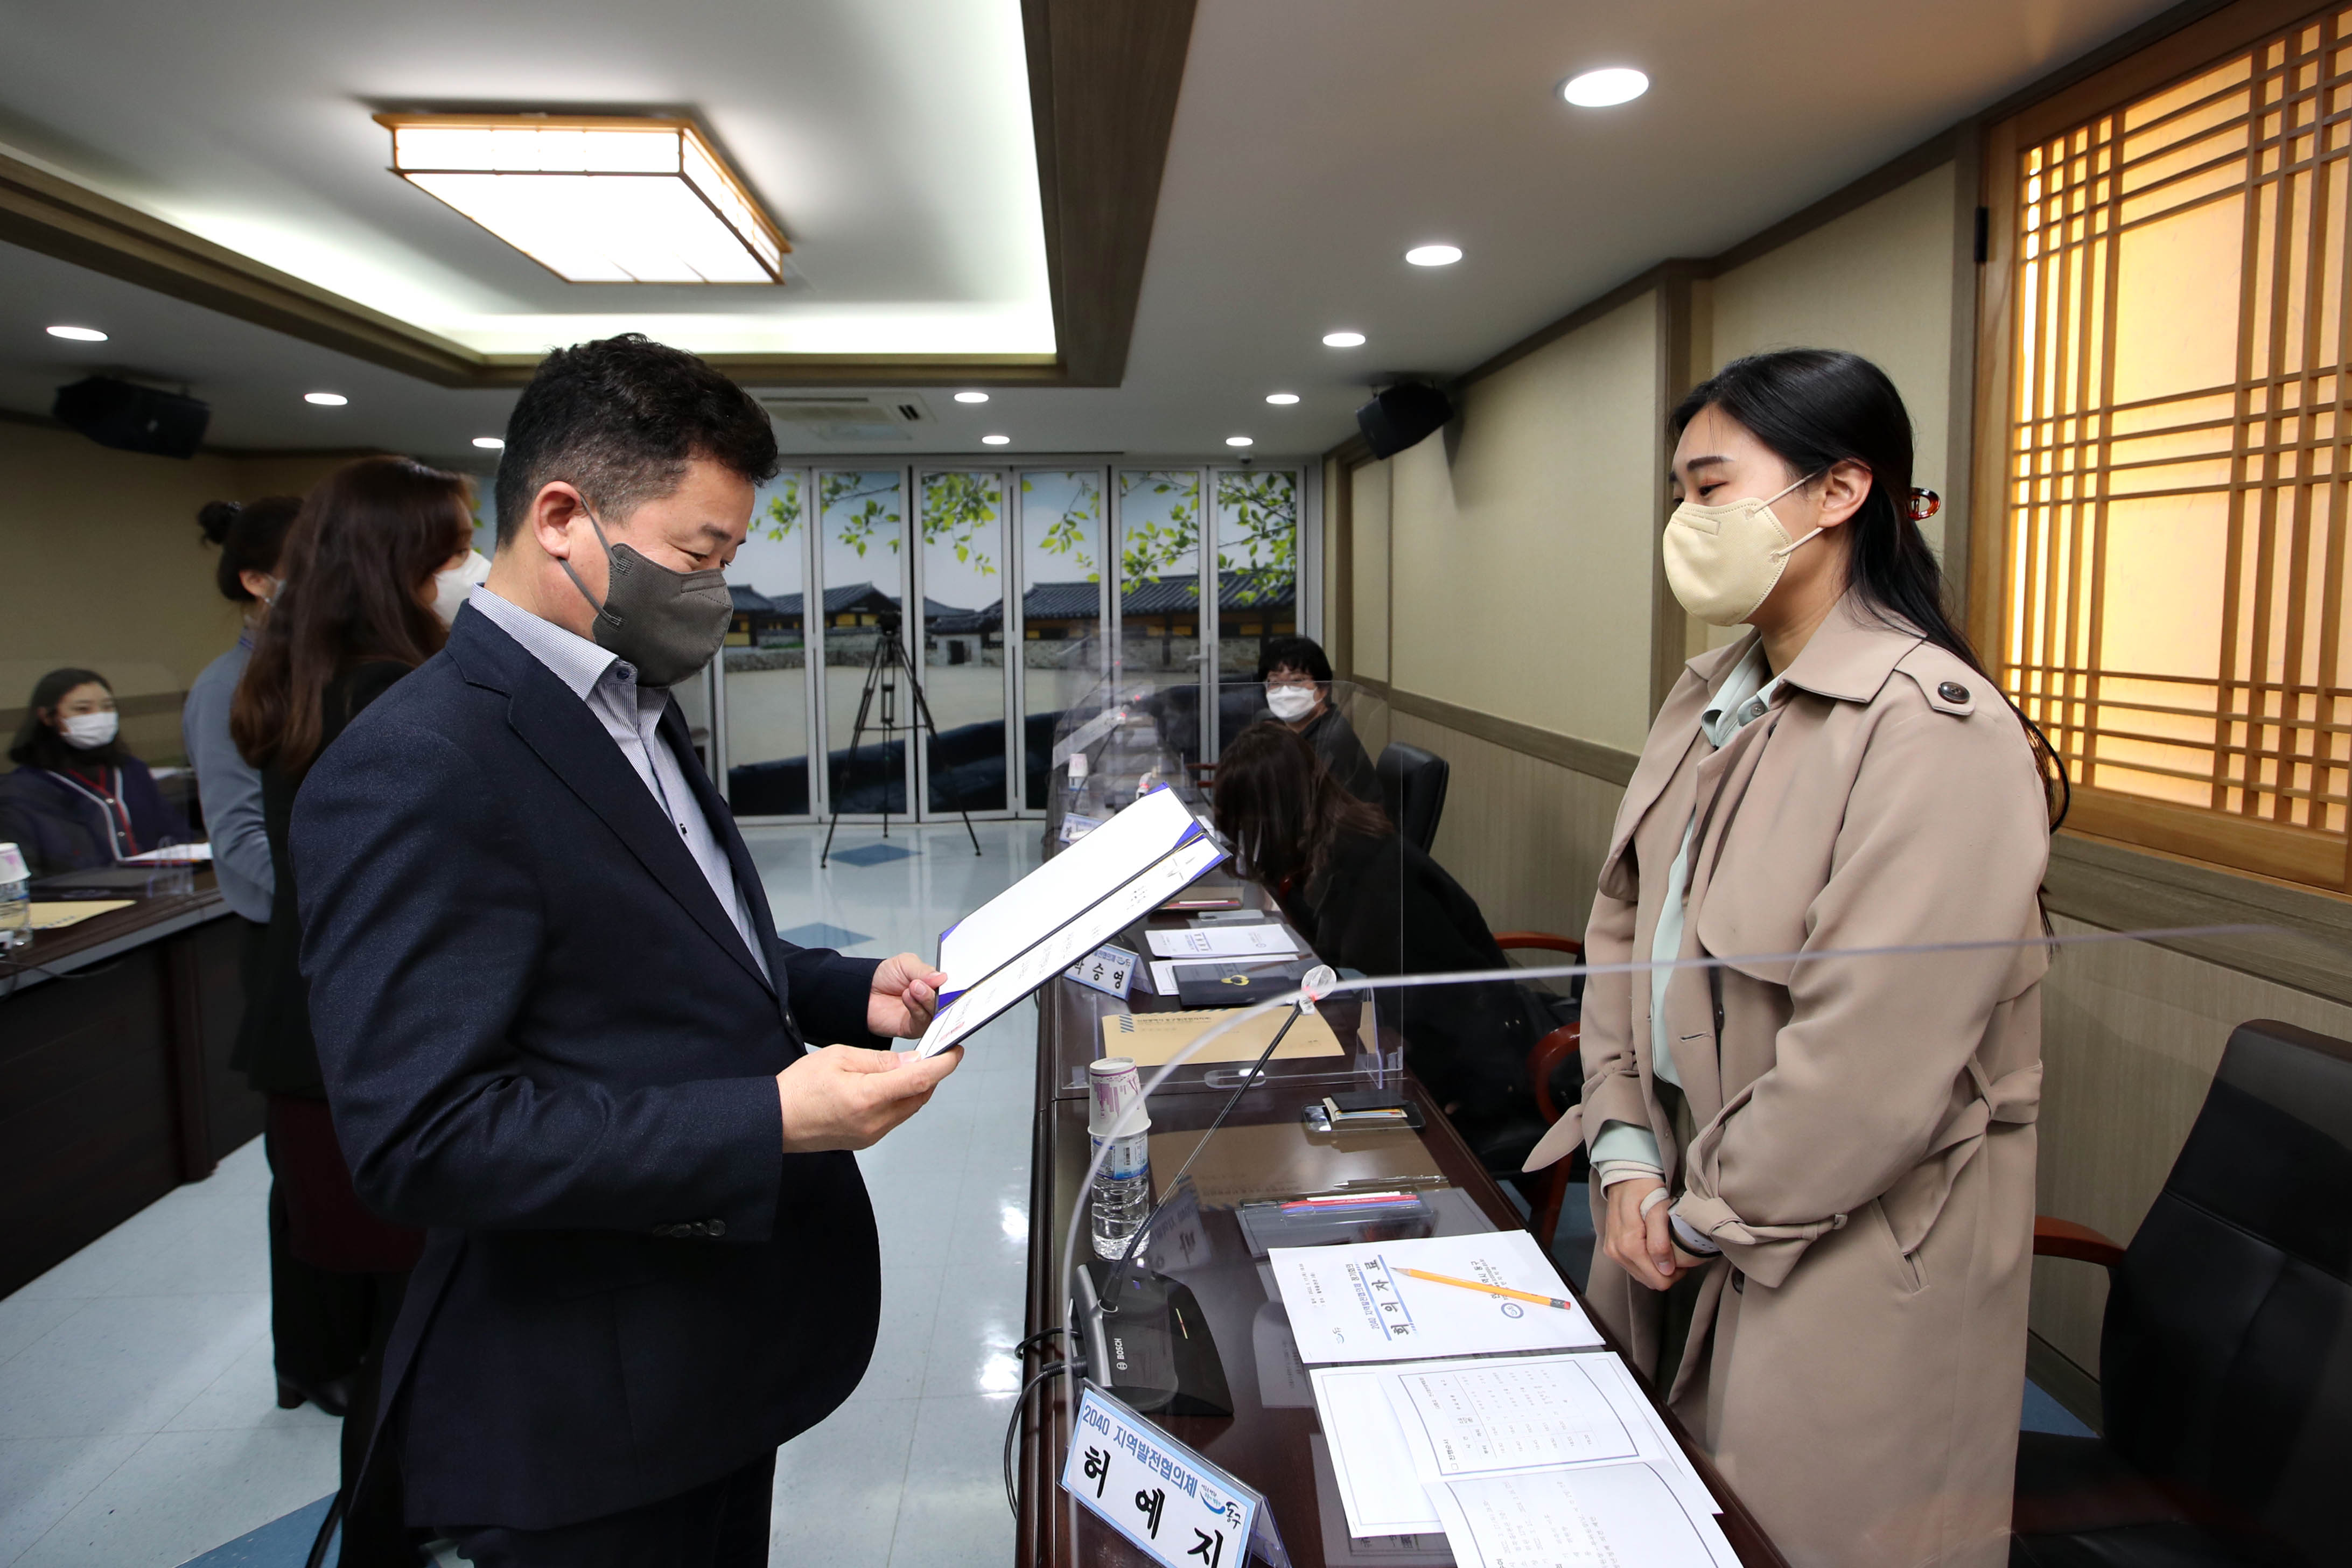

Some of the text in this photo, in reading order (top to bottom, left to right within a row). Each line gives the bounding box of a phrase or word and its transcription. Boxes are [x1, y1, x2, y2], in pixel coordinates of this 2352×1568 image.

[1093, 963, 1104, 981] 승
[1114, 971, 1124, 989] 영
[1371, 1280, 1389, 1291] 자
[1381, 1302, 1398, 1312] 의
[1368, 1317, 1380, 1329] 2040
[1391, 1325, 1409, 1335] 회
[1114, 1338, 1125, 1360] BOSCH
[1082, 1404, 1110, 1436] 2040
[1113, 1425, 1198, 1499] 지역발전협의체
[1084, 1445, 1111, 1499] 허
[1135, 1488, 1165, 1540] 예
[1187, 1527, 1223, 1568] 지
